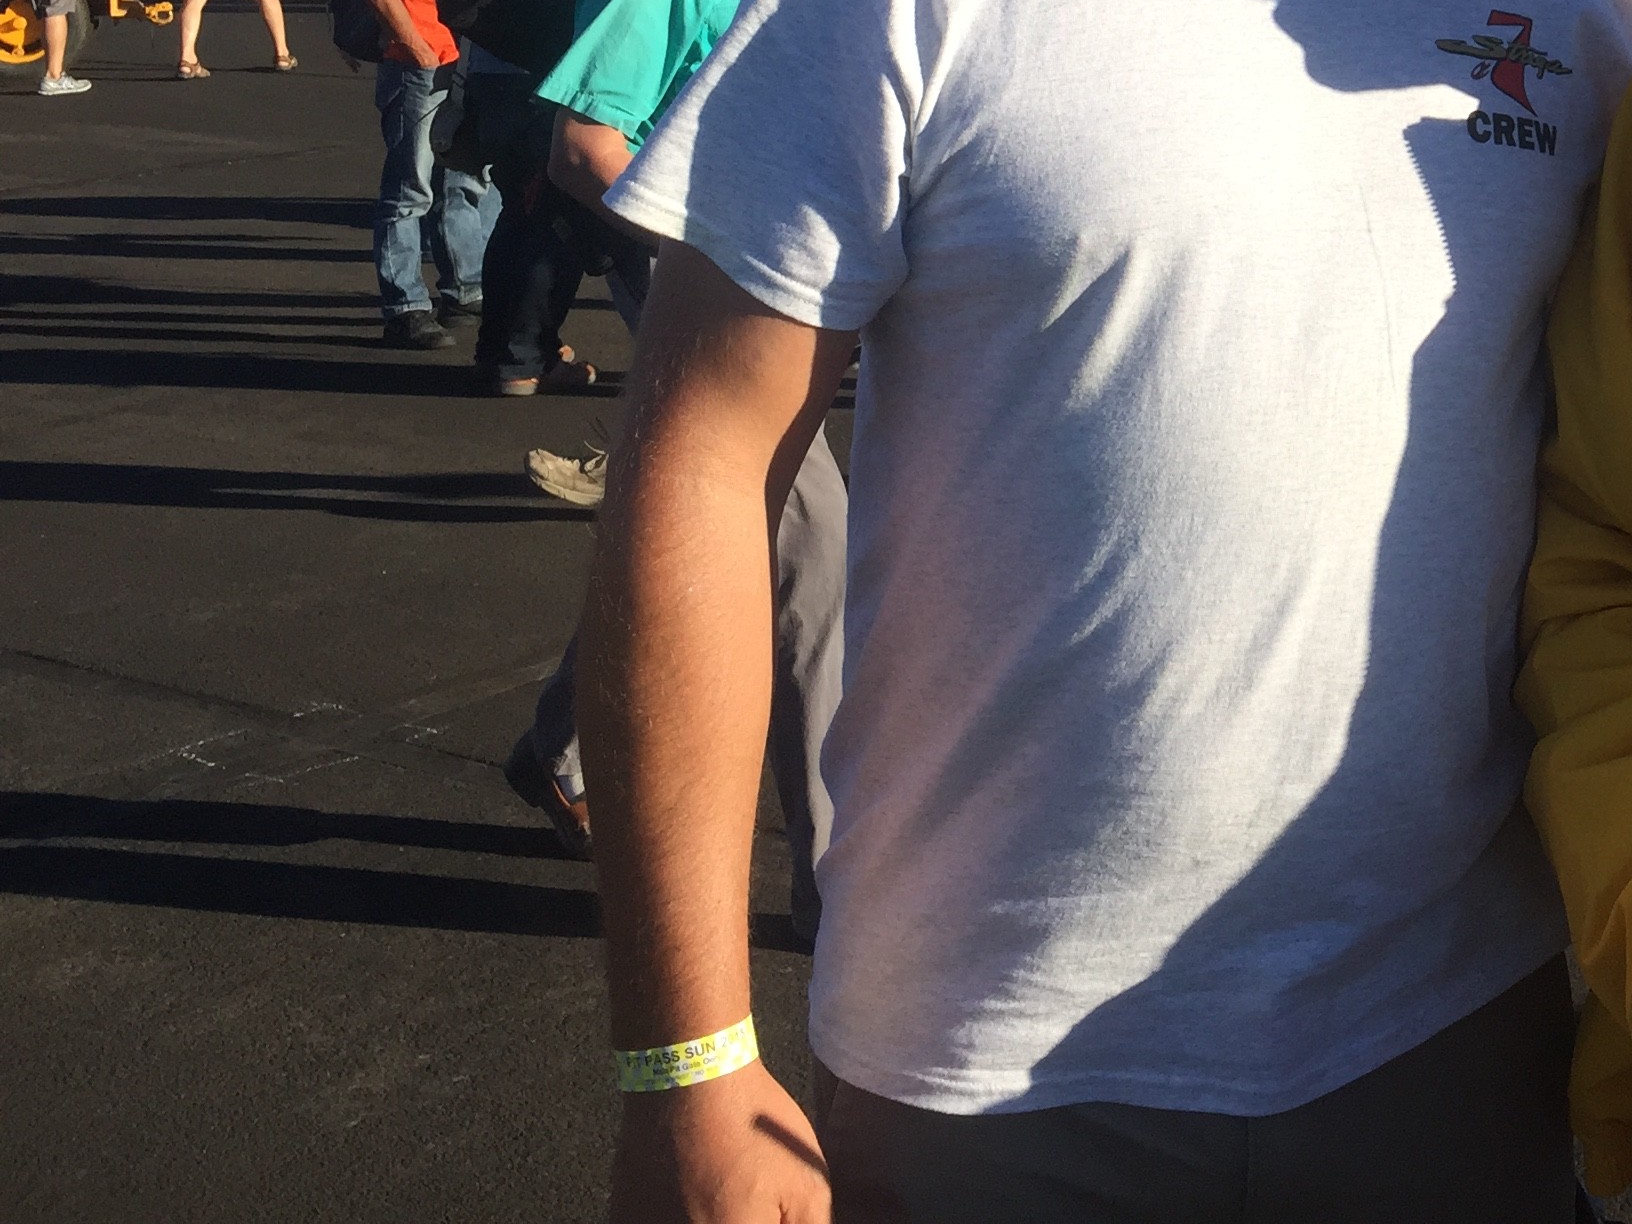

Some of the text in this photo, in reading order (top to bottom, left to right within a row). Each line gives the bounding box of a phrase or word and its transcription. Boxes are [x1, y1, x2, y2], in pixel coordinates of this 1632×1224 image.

[1467, 110, 1557, 156] CREW
[645, 1050, 680, 1067] PASS
[684, 1040, 716, 1060] SUN
